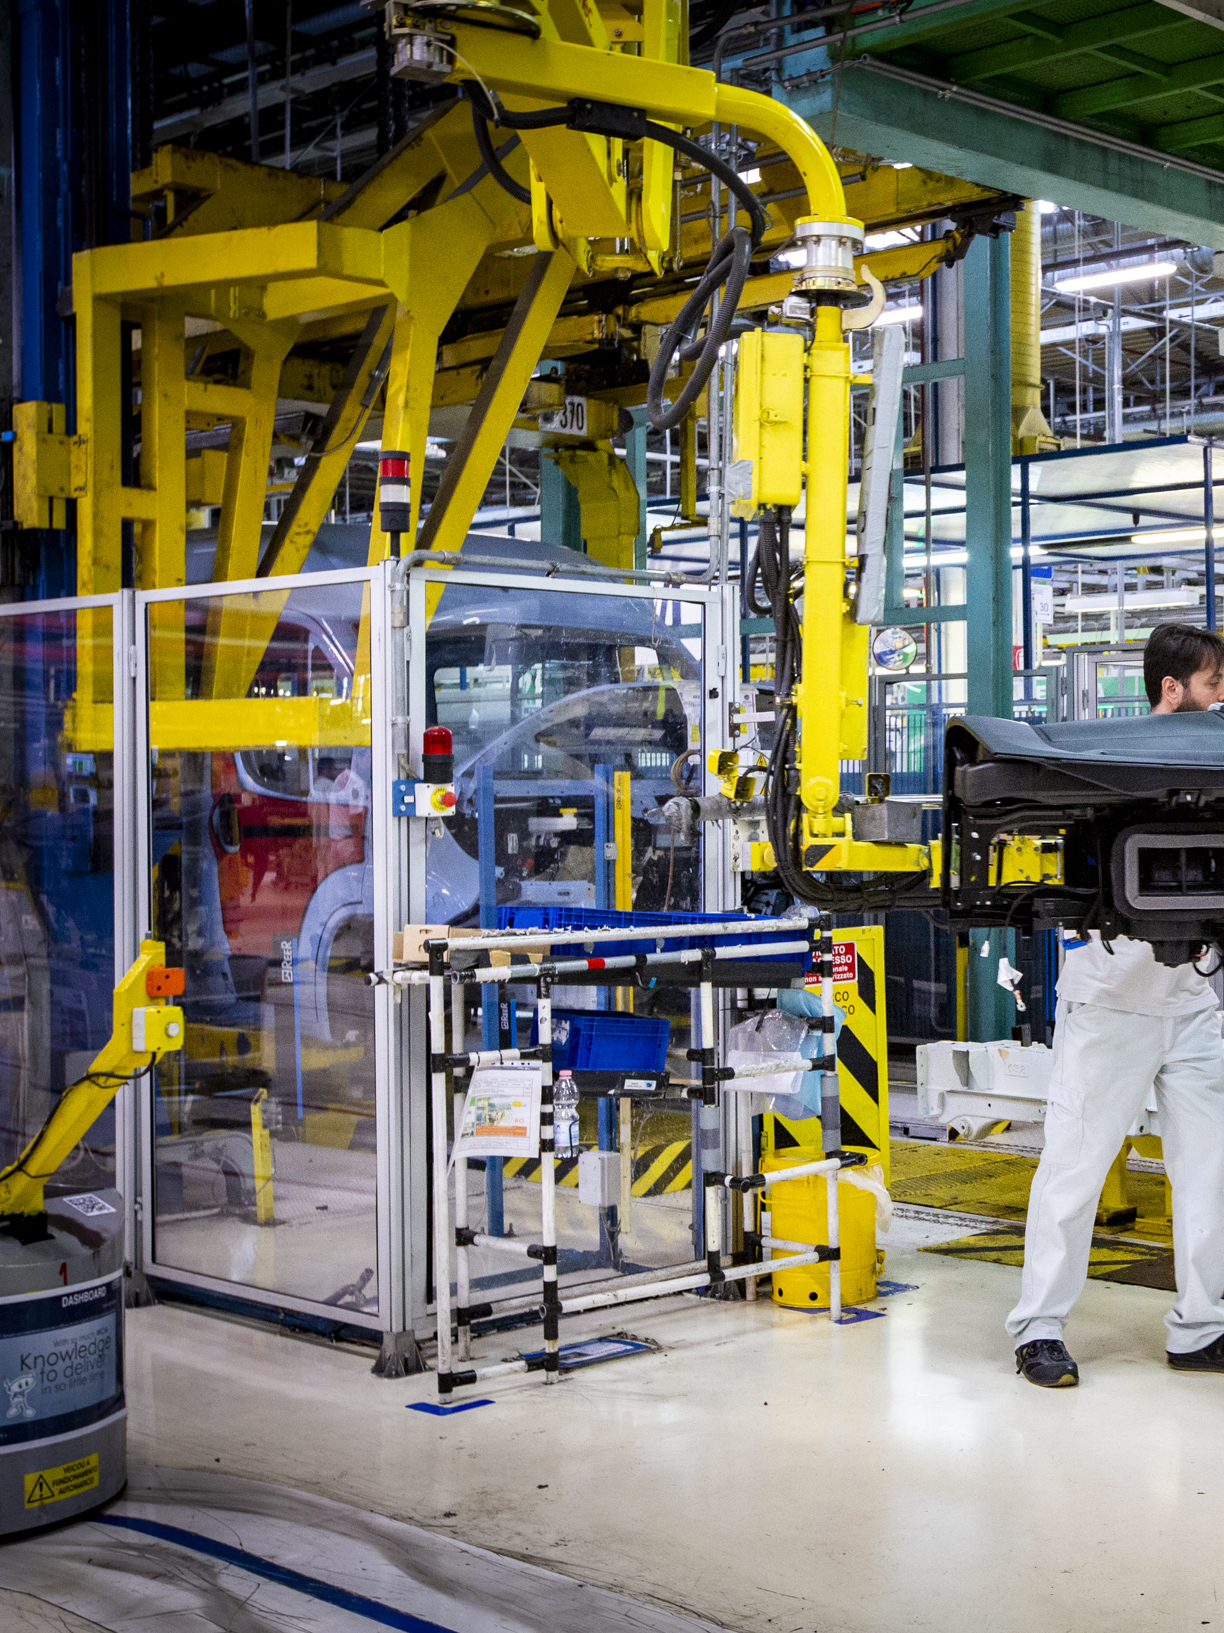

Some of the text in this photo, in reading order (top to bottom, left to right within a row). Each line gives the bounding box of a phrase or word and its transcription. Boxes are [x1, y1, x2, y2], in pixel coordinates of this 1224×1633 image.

[1039, 602, 1049, 612] 30
[61, 1286, 107, 1308] DASHBOARD
[20, 1336, 112, 1372] Knowledge
[40, 1353, 107, 1383] to deliver
[41, 1385, 52, 1396] in
[54, 1382, 66, 1393] so
